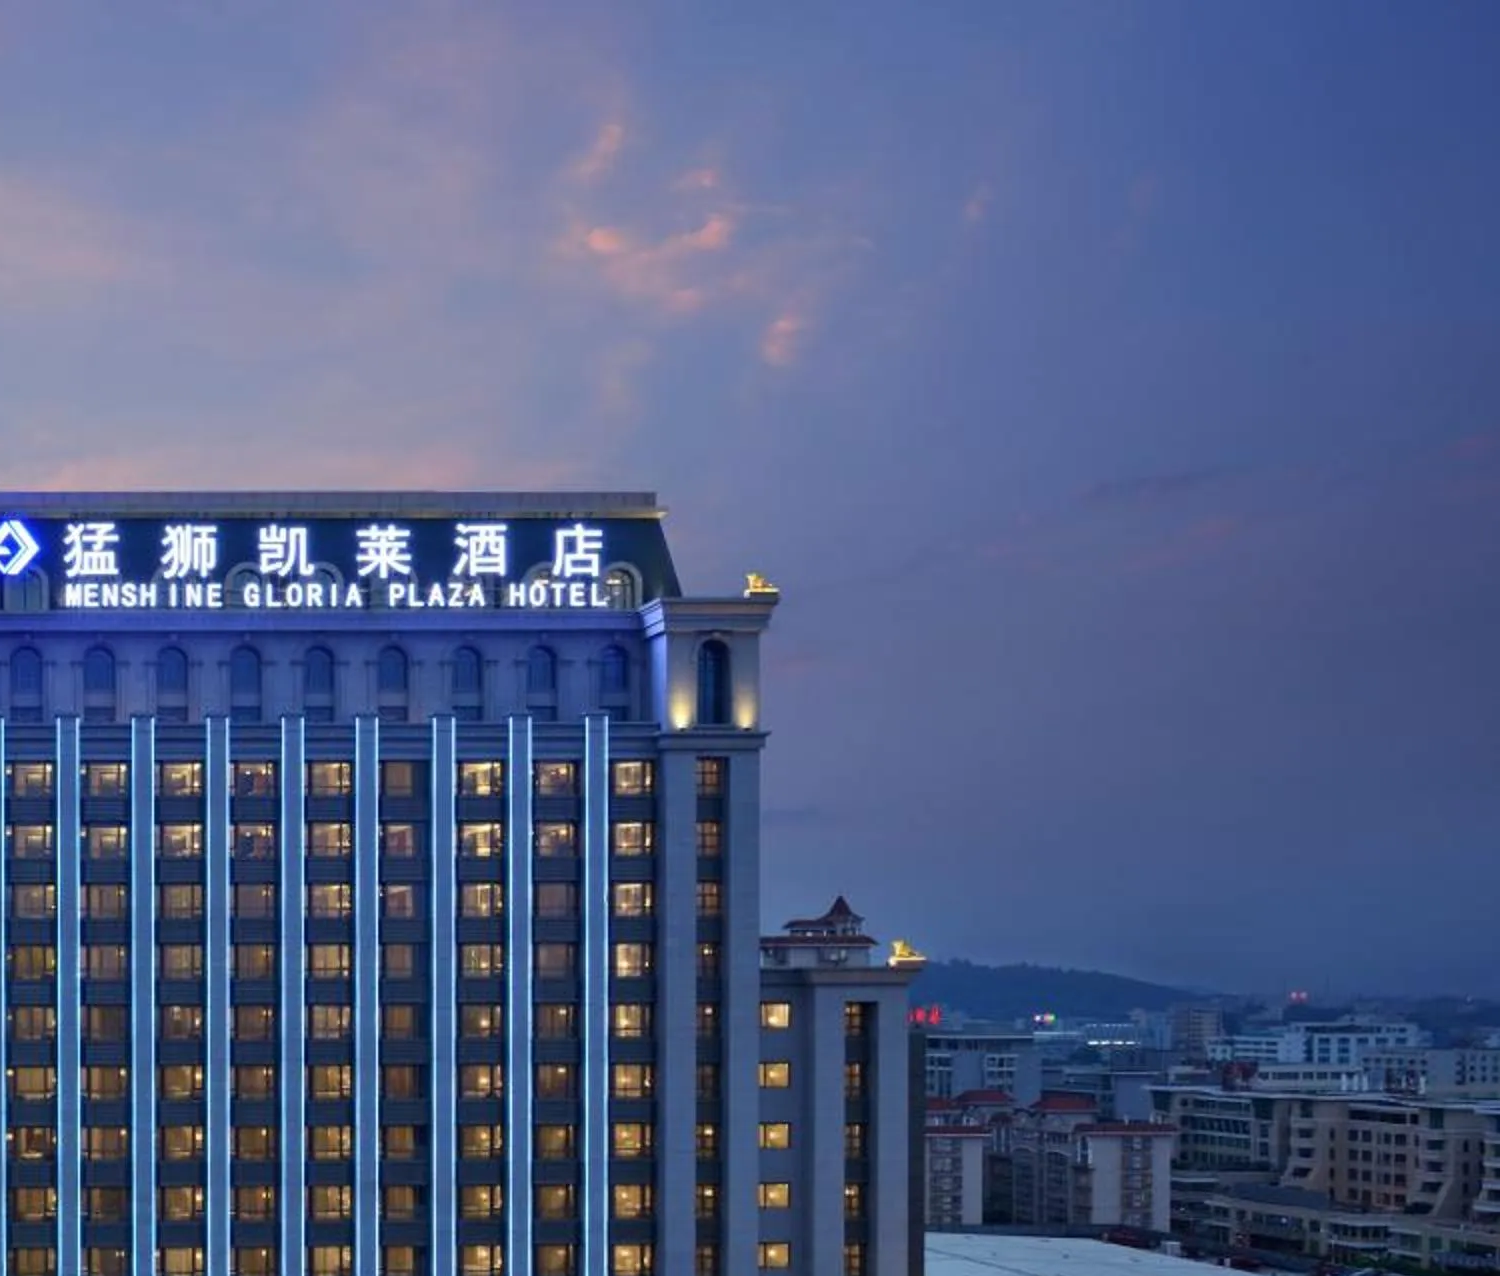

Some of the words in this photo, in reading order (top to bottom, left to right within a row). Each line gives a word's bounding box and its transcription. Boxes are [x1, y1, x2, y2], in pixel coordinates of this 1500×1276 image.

[63, 522, 603, 578] 猛狮凯莱酒店
[244, 583, 363, 608] GLORIA
[389, 583, 486, 608] PLAZA
[508, 583, 608, 608] HOTEL
